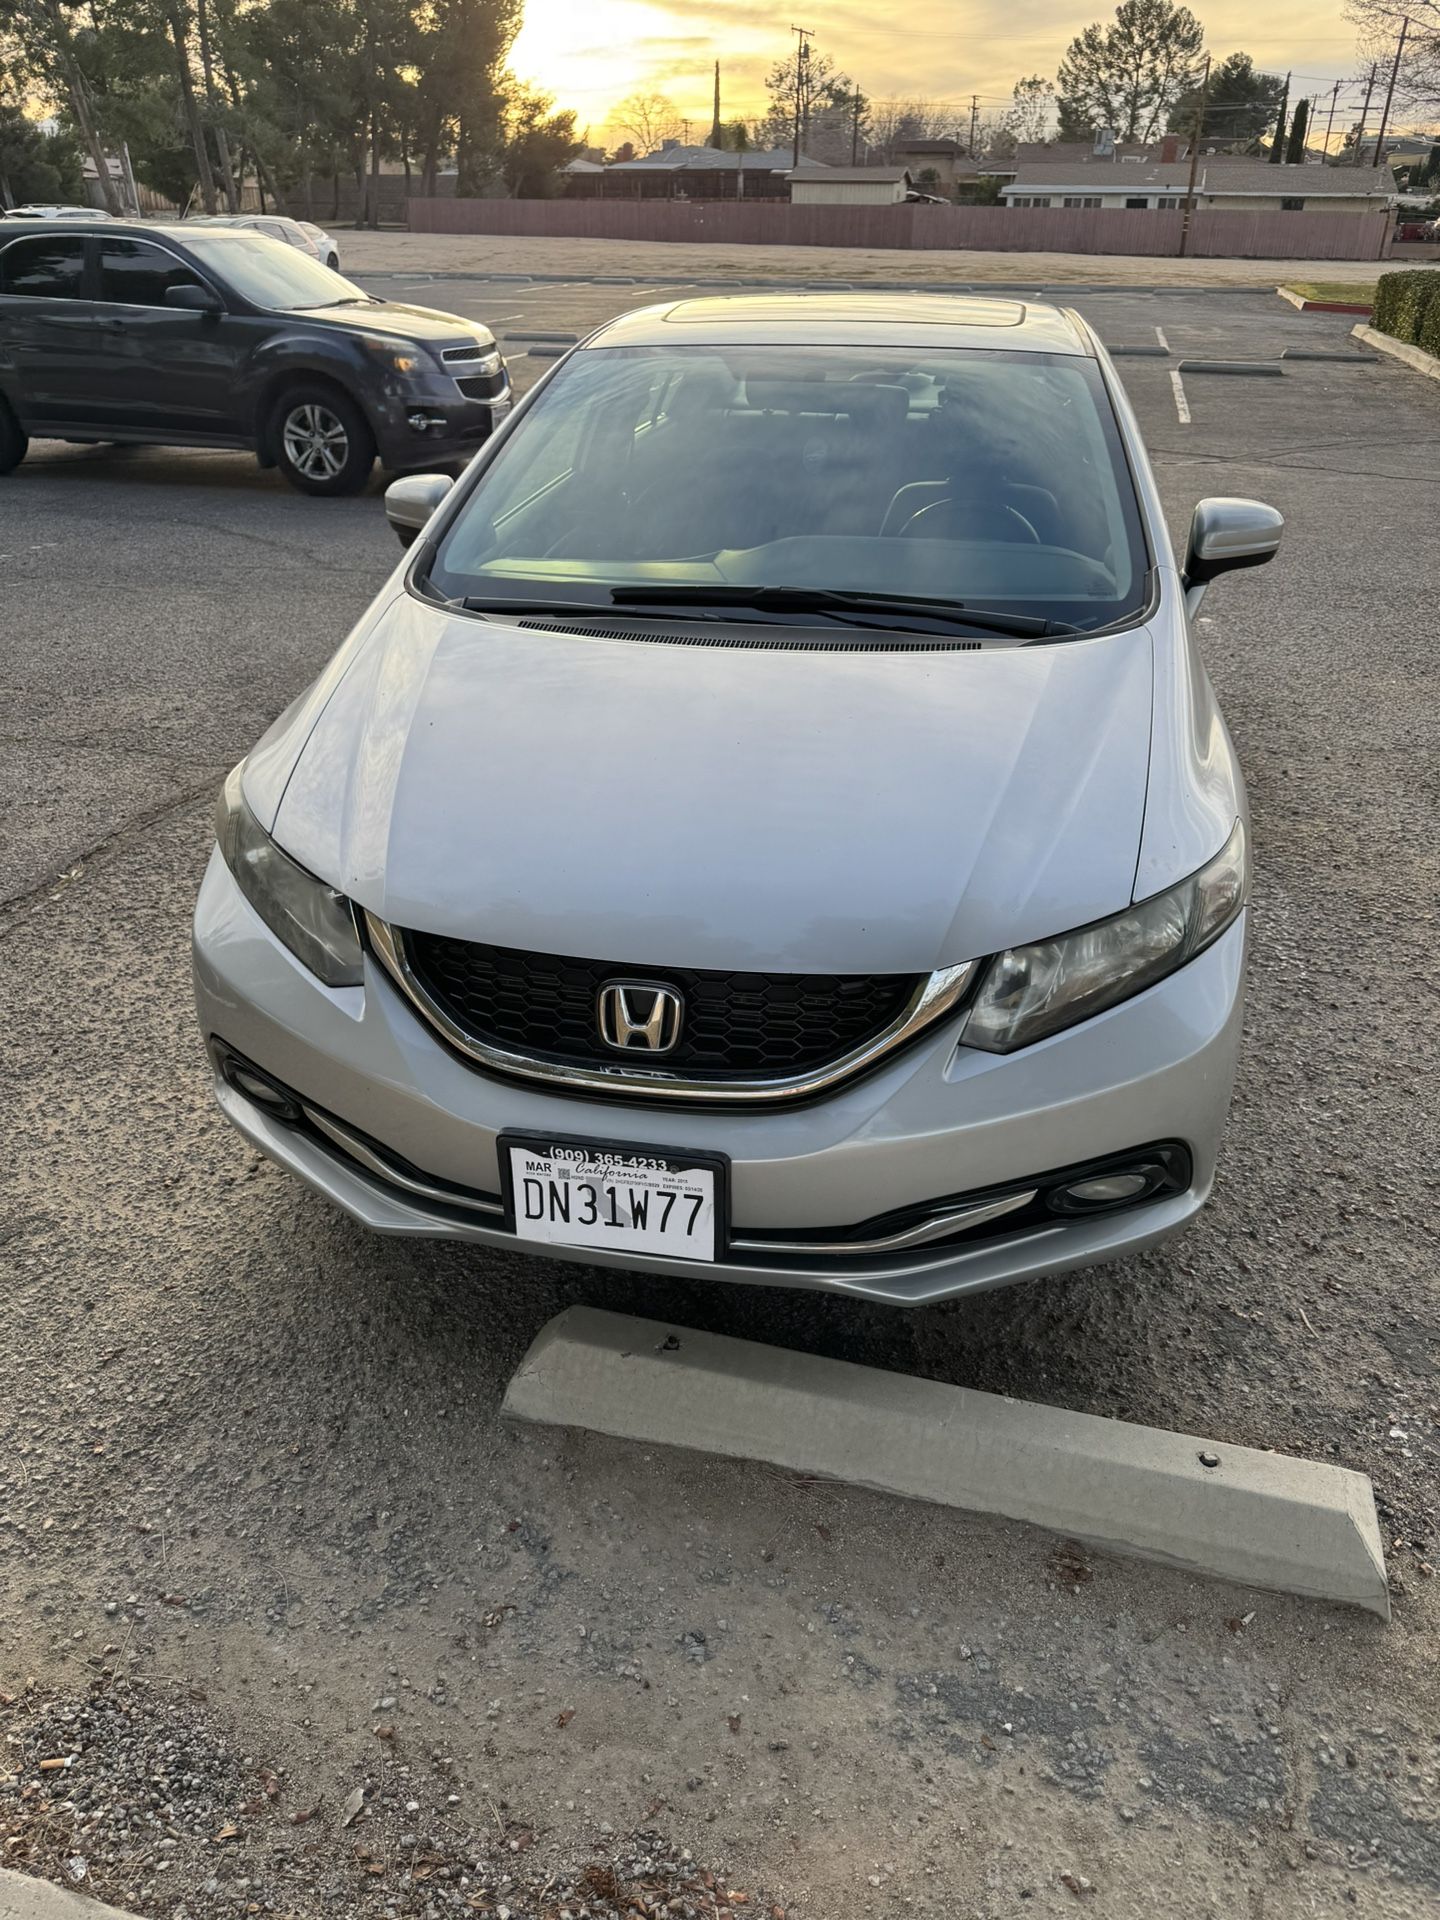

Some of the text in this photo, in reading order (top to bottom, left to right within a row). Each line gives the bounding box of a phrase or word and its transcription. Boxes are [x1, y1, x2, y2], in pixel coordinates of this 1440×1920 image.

[525, 1160, 552, 1173] MAR
[549, 1146, 668, 1171] (909) 365-4233
[575, 1162, 648, 1181] California
[523, 1177, 704, 1236] DN31W77
